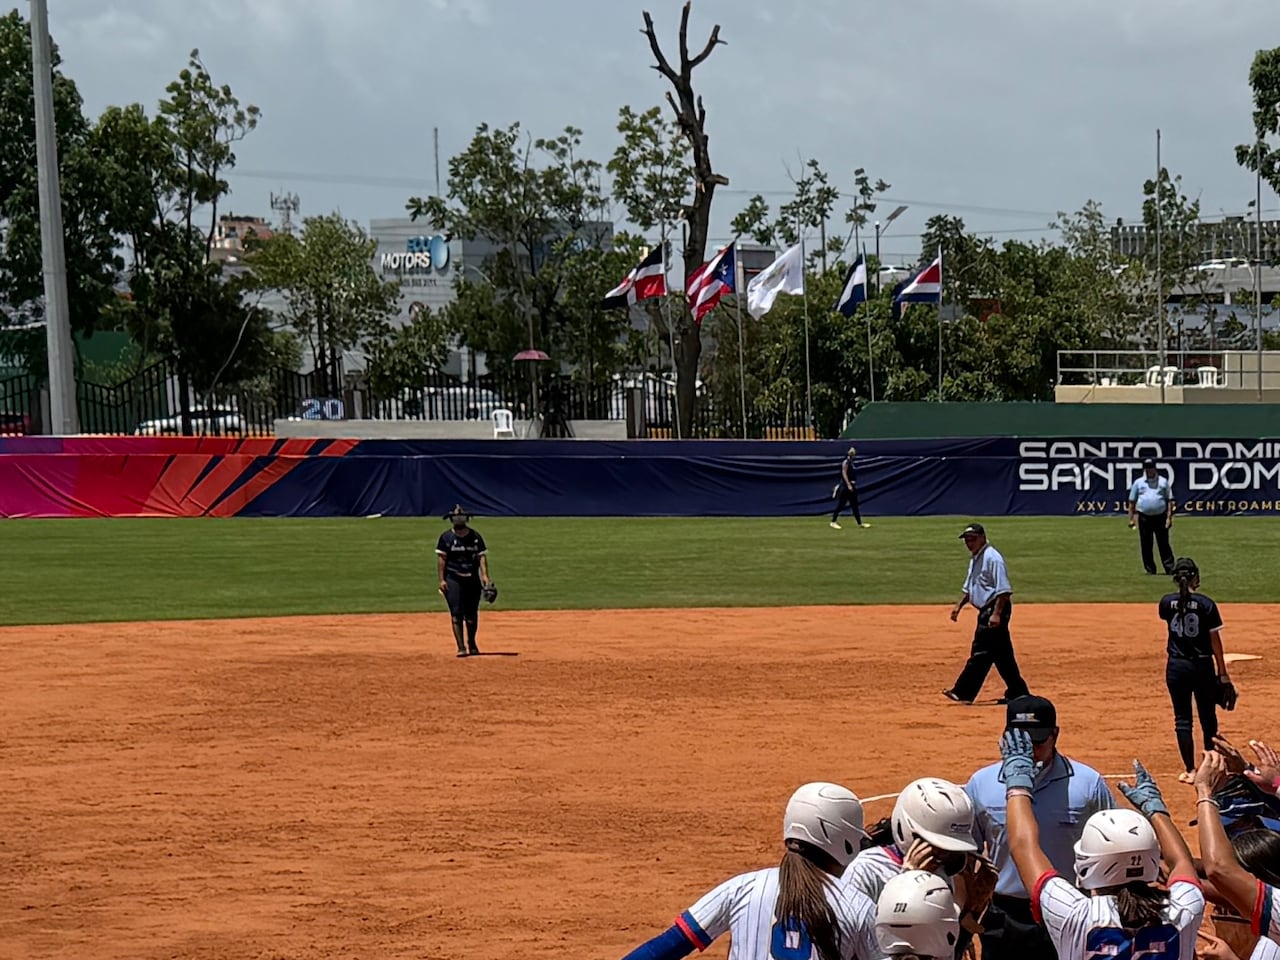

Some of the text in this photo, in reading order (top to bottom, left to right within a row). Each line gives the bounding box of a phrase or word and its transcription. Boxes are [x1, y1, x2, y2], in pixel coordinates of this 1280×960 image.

[381, 251, 432, 269] MOTORS
[1076, 501, 1107, 512] XXV
[1170, 613, 1199, 638] 48
